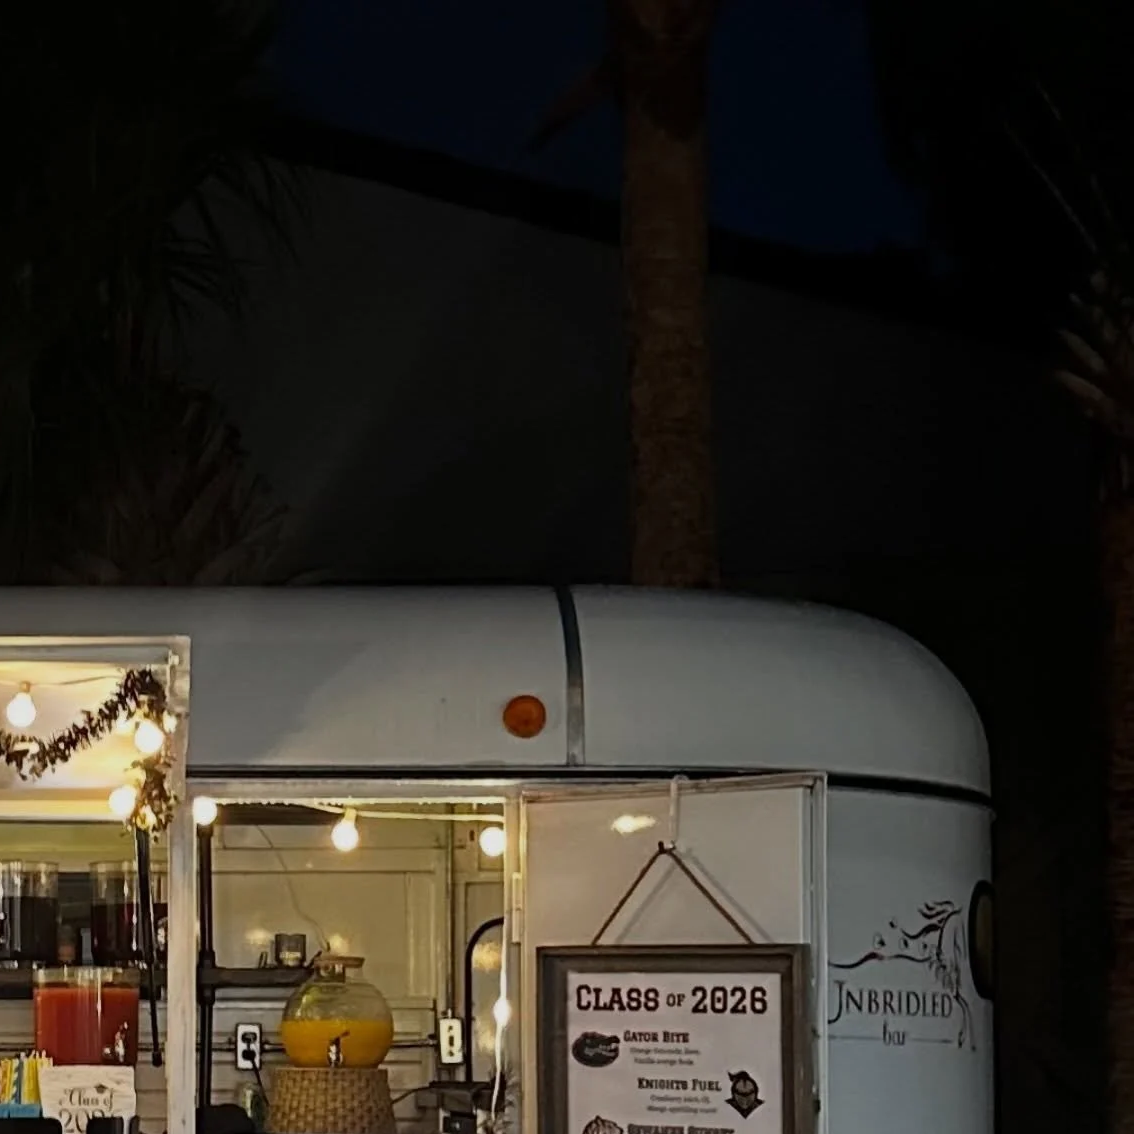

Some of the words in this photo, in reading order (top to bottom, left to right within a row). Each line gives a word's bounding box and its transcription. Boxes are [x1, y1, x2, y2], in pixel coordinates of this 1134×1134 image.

[576, 984, 660, 1012] CLASS
[691, 986, 768, 1014] 2026
[882, 1020, 907, 1046] bar
